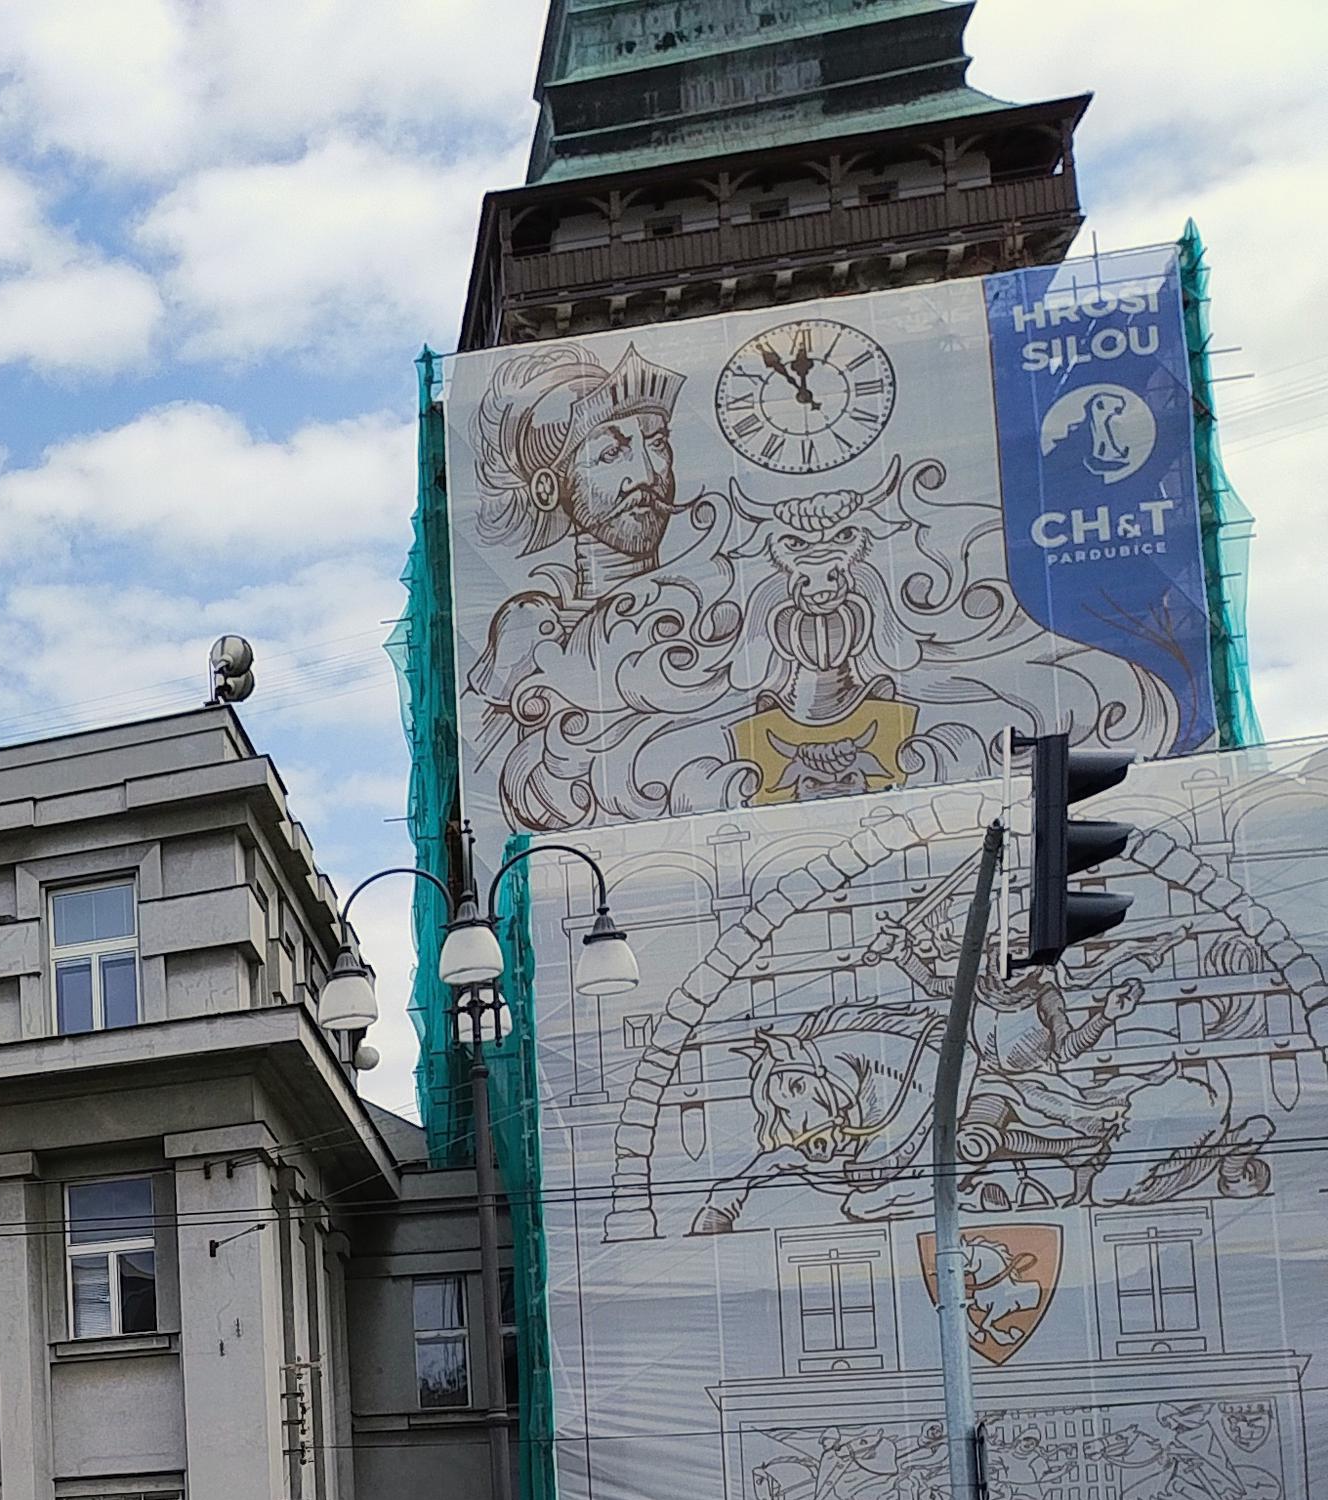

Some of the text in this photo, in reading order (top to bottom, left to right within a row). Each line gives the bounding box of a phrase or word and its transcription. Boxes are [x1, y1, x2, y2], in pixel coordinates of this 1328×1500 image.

[1022, 325, 1160, 372] SILOU
[1031, 500, 1174, 548] CH&T
[1047, 541, 1167, 566] PARDUBICE
